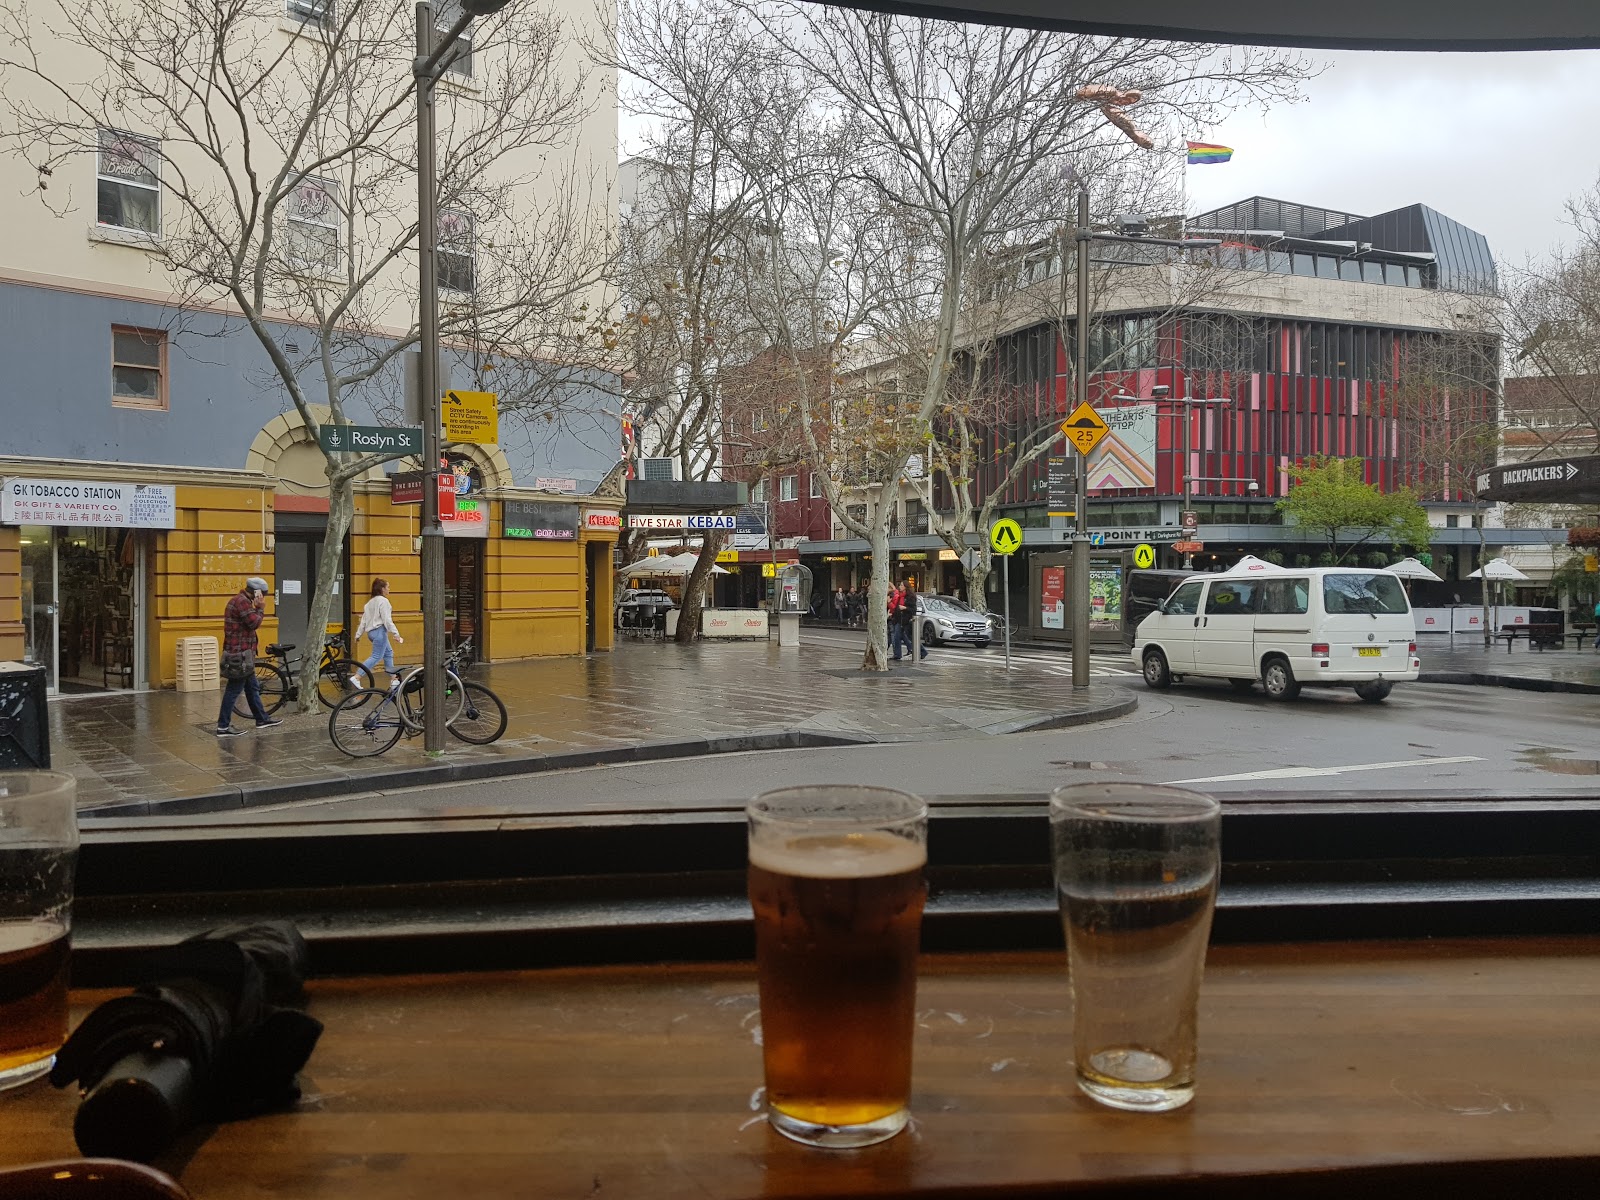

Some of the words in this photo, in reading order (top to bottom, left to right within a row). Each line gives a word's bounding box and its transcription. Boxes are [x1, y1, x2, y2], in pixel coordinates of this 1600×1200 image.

[1101, 412, 1144, 422] ETHEARTS
[352, 432, 394, 448] Roslyn
[398, 434, 411, 446] St
[1077, 431, 1093, 441] 25
[1503, 466, 1563, 485] BACKPACKERS
[442, 477, 450, 485] NO
[13, 484, 28, 495] GK
[30, 485, 80, 497] TOBACCO
[83, 487, 121, 499] STATION
[459, 502, 478, 510] BEST
[523, 503, 542, 513] BEST
[455, 512, 482, 521] ABS
[630, 519, 653, 528] FIVE
[656, 519, 682, 528] STAR
[687, 516, 734, 528] KEBAB
[506, 528, 532, 537] PIZZA
[1104, 531, 1140, 539] POINT
